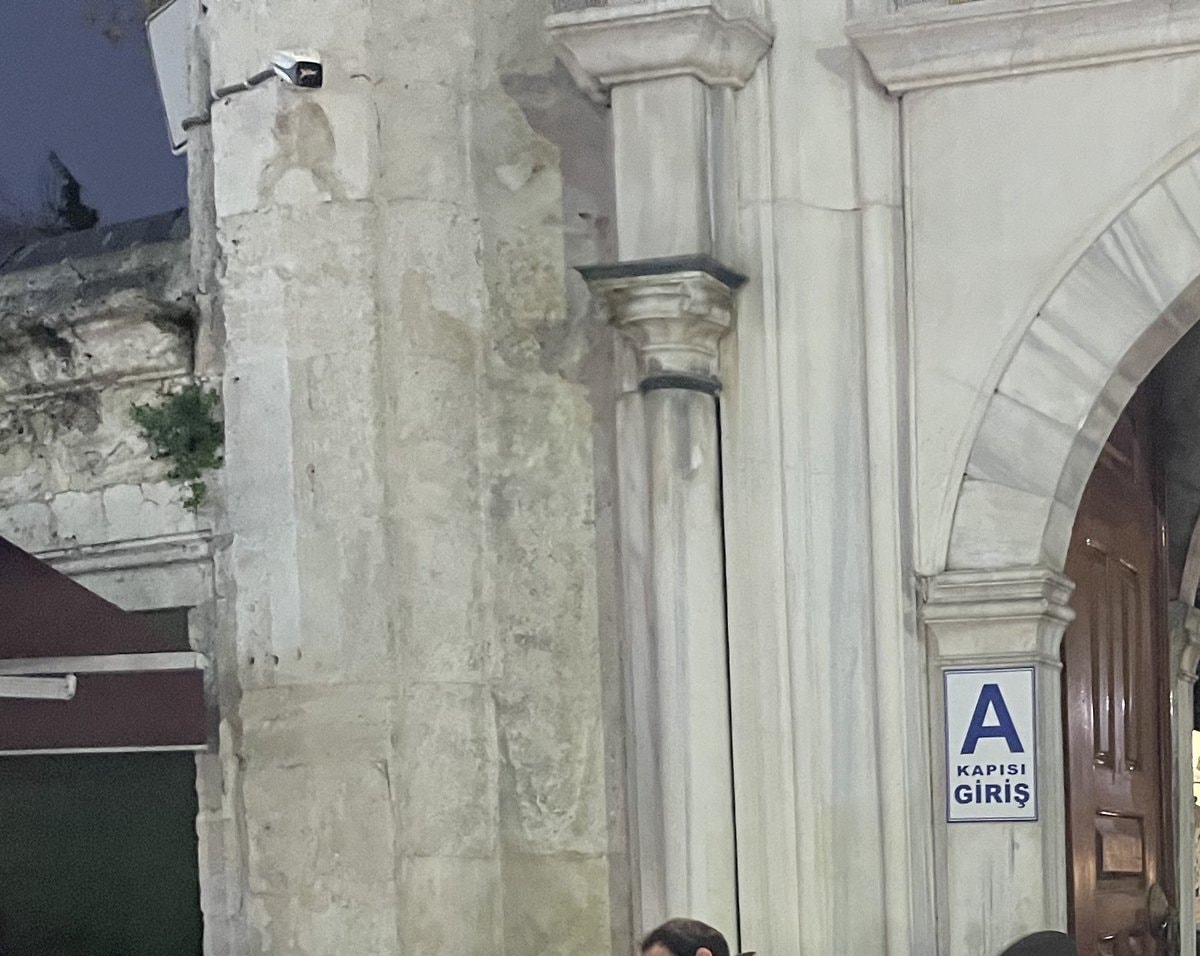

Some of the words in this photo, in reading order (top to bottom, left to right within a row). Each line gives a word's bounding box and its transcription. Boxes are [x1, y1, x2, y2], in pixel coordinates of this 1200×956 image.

[960, 684, 1025, 755] A
[957, 764, 1026, 777] KAPISI
[954, 778, 1030, 808] GİRİŞ
